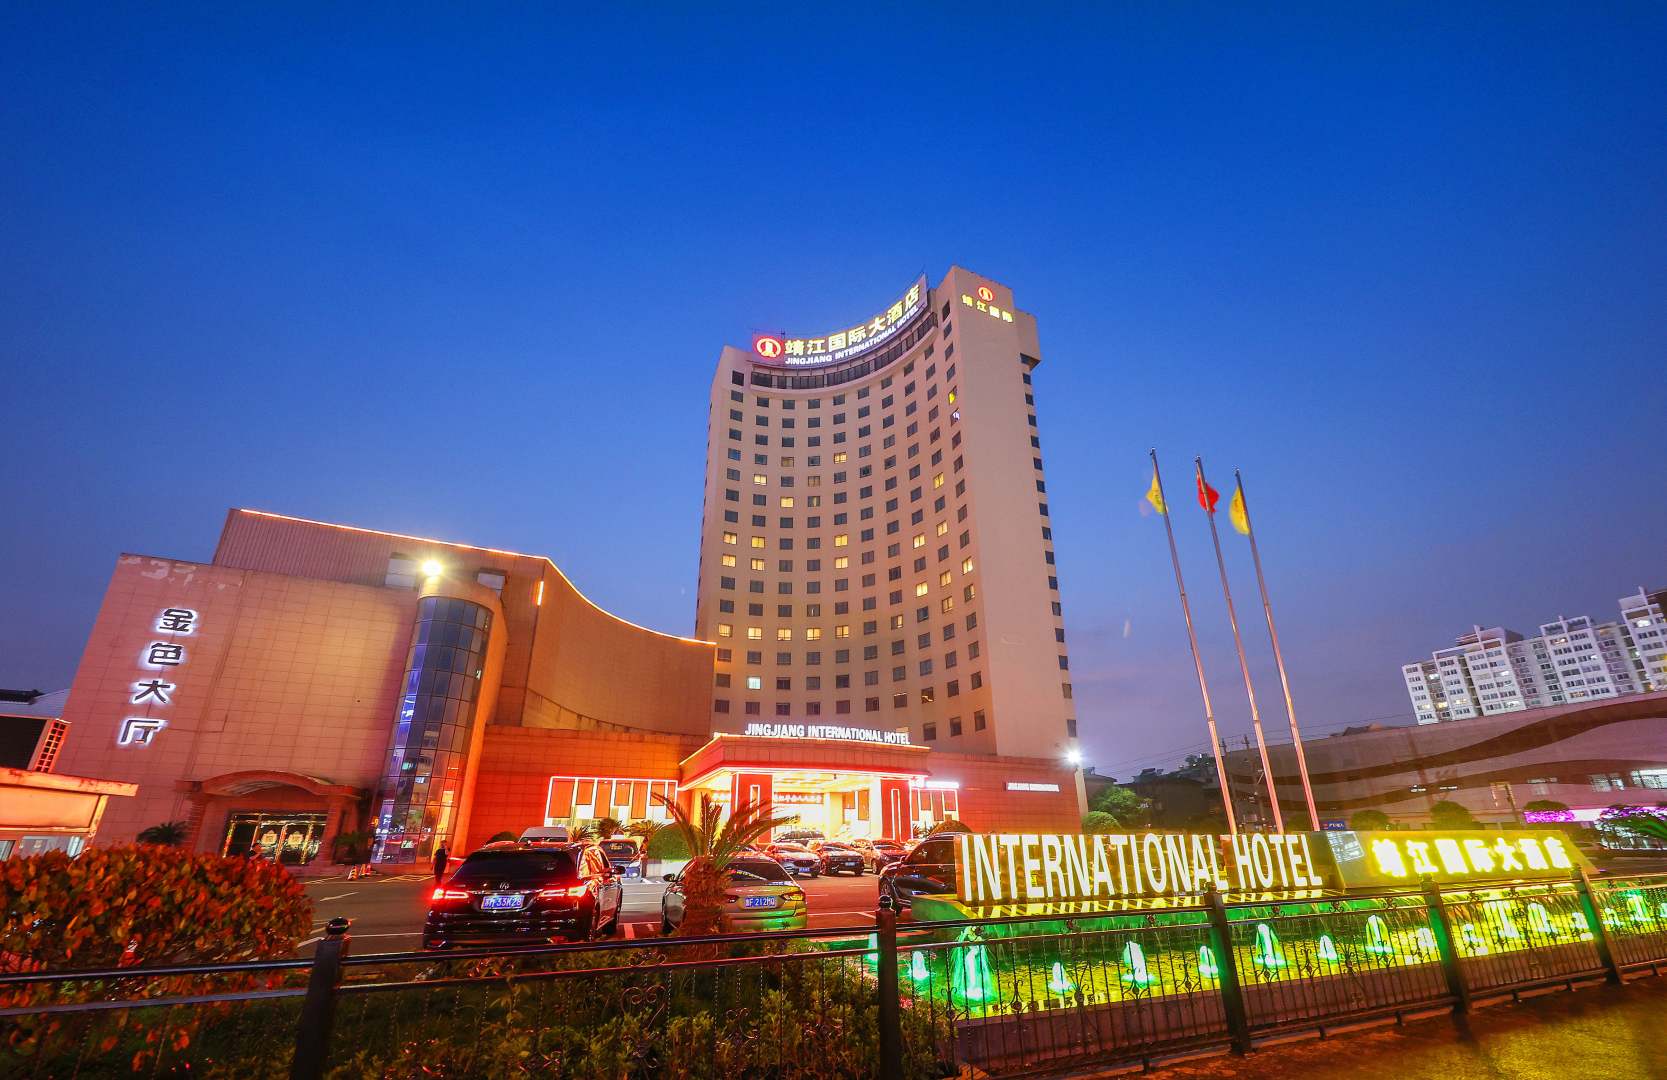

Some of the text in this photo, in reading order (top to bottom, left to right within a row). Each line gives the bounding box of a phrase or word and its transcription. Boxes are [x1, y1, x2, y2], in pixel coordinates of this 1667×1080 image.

[784, 284, 919, 356] 靖江国际大酒店
[785, 304, 919, 365] JINGJIANG INTERNATIONAL HOTEL
[118, 607, 196, 745] 金色大厅
[744, 722, 911, 745] JINGJIANG INTERNATIONAL HOTEL
[961, 833, 1229, 902] INTERNATIONAL
[1231, 833, 1323, 890] HOTEL
